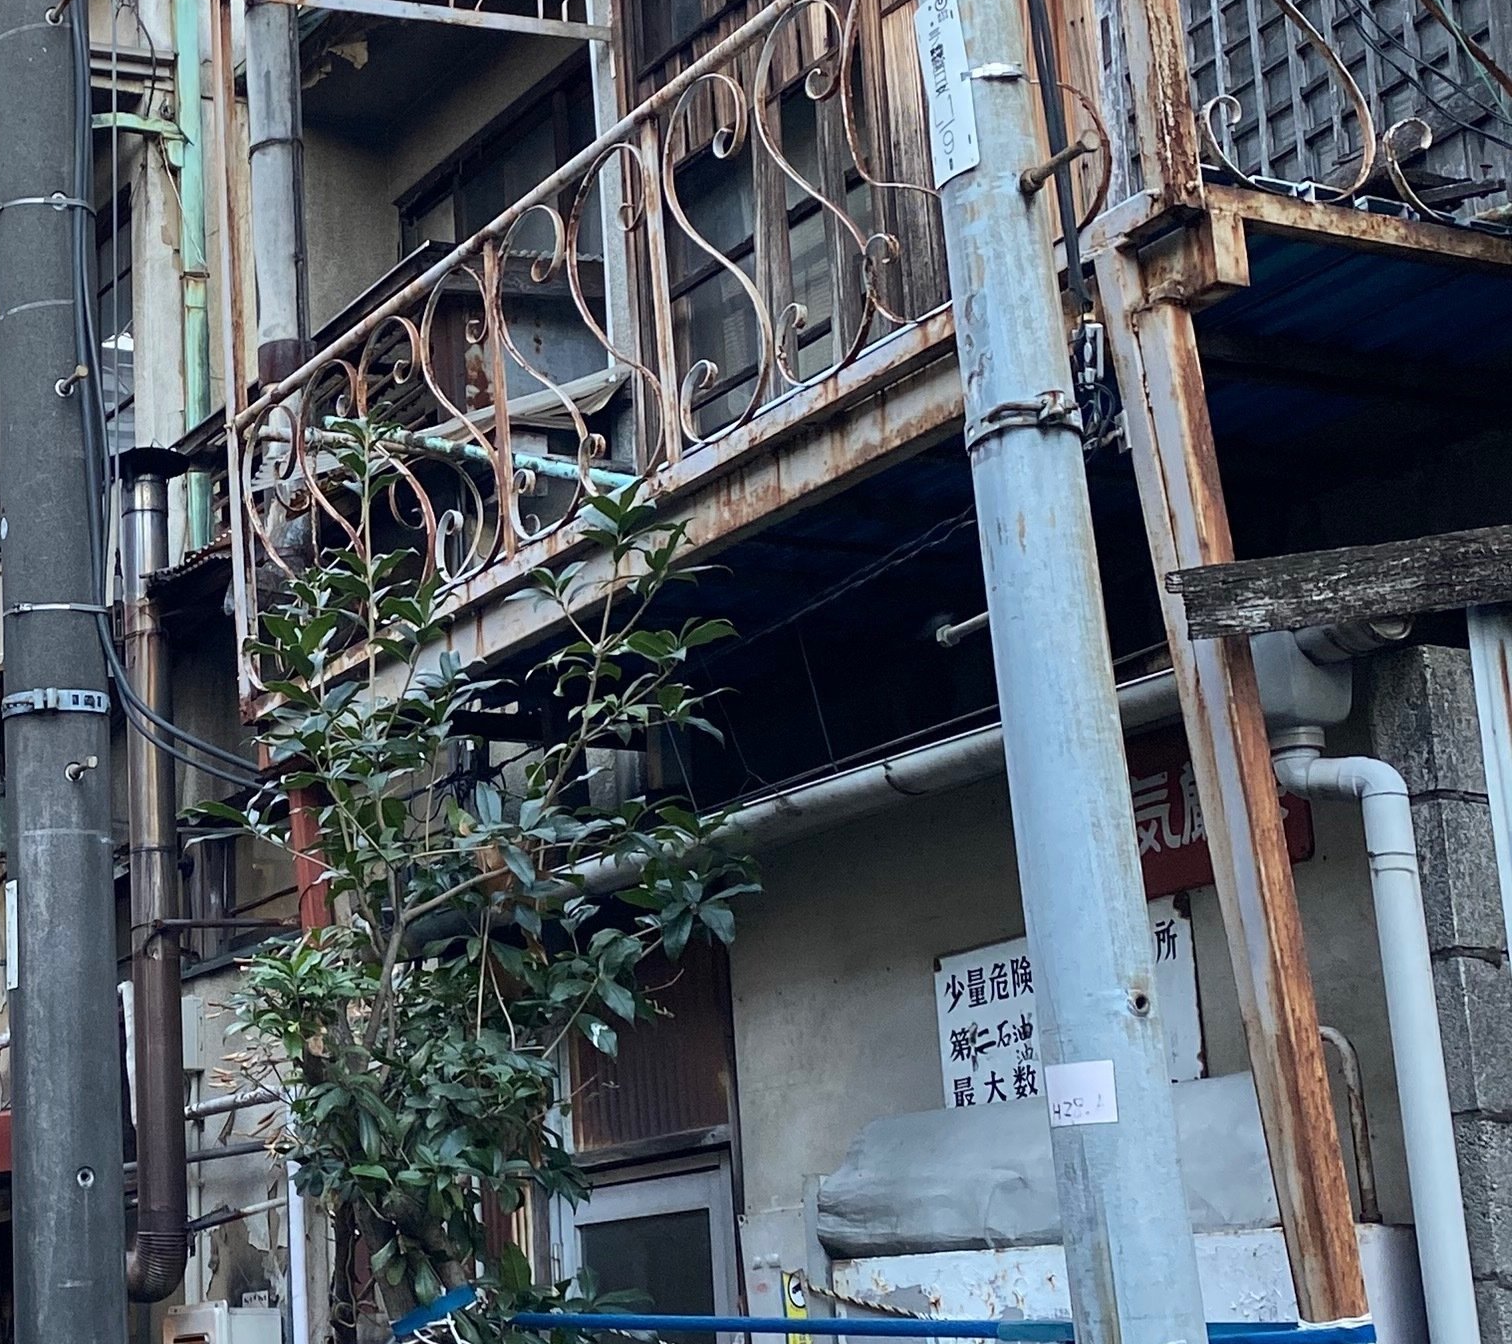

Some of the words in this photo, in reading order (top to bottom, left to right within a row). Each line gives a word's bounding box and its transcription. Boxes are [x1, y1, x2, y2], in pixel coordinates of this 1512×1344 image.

[944, 955, 1034, 1014] 少量危険
[1154, 918, 1178, 965] 所
